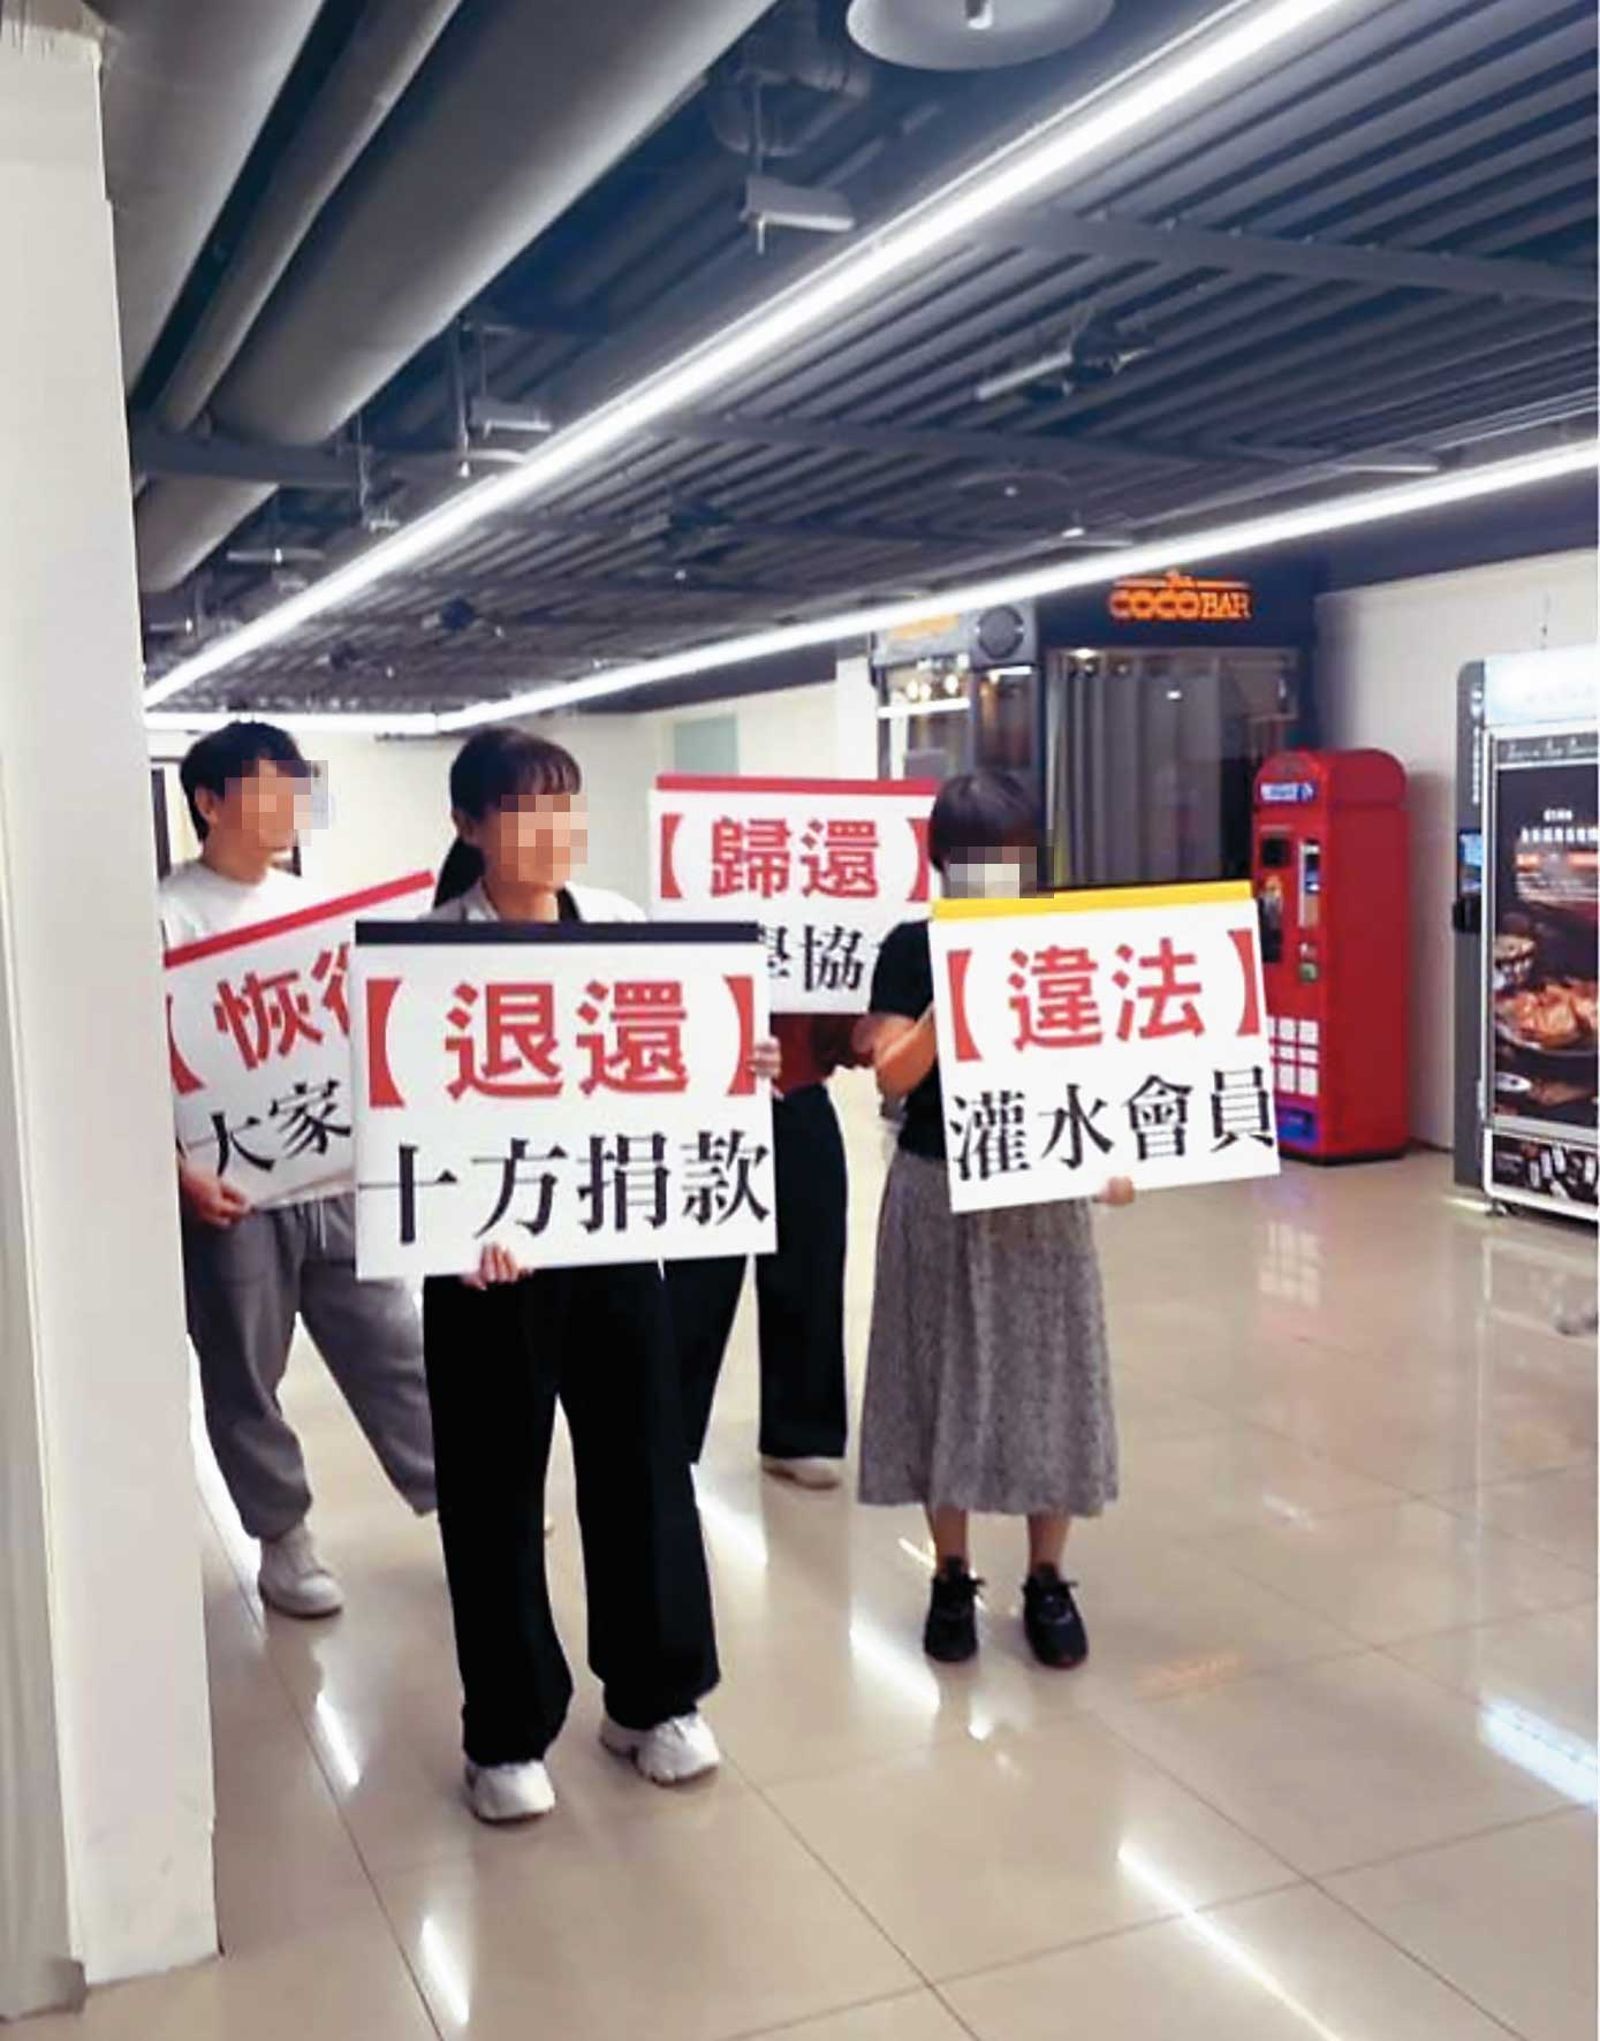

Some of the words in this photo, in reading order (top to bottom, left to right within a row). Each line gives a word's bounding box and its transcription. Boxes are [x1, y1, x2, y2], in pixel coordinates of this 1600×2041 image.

[1110, 589, 1198, 620] COCO
[949, 1066, 1274, 1182] 灌水會員
[358, 1130, 770, 1246] 十方捐款
